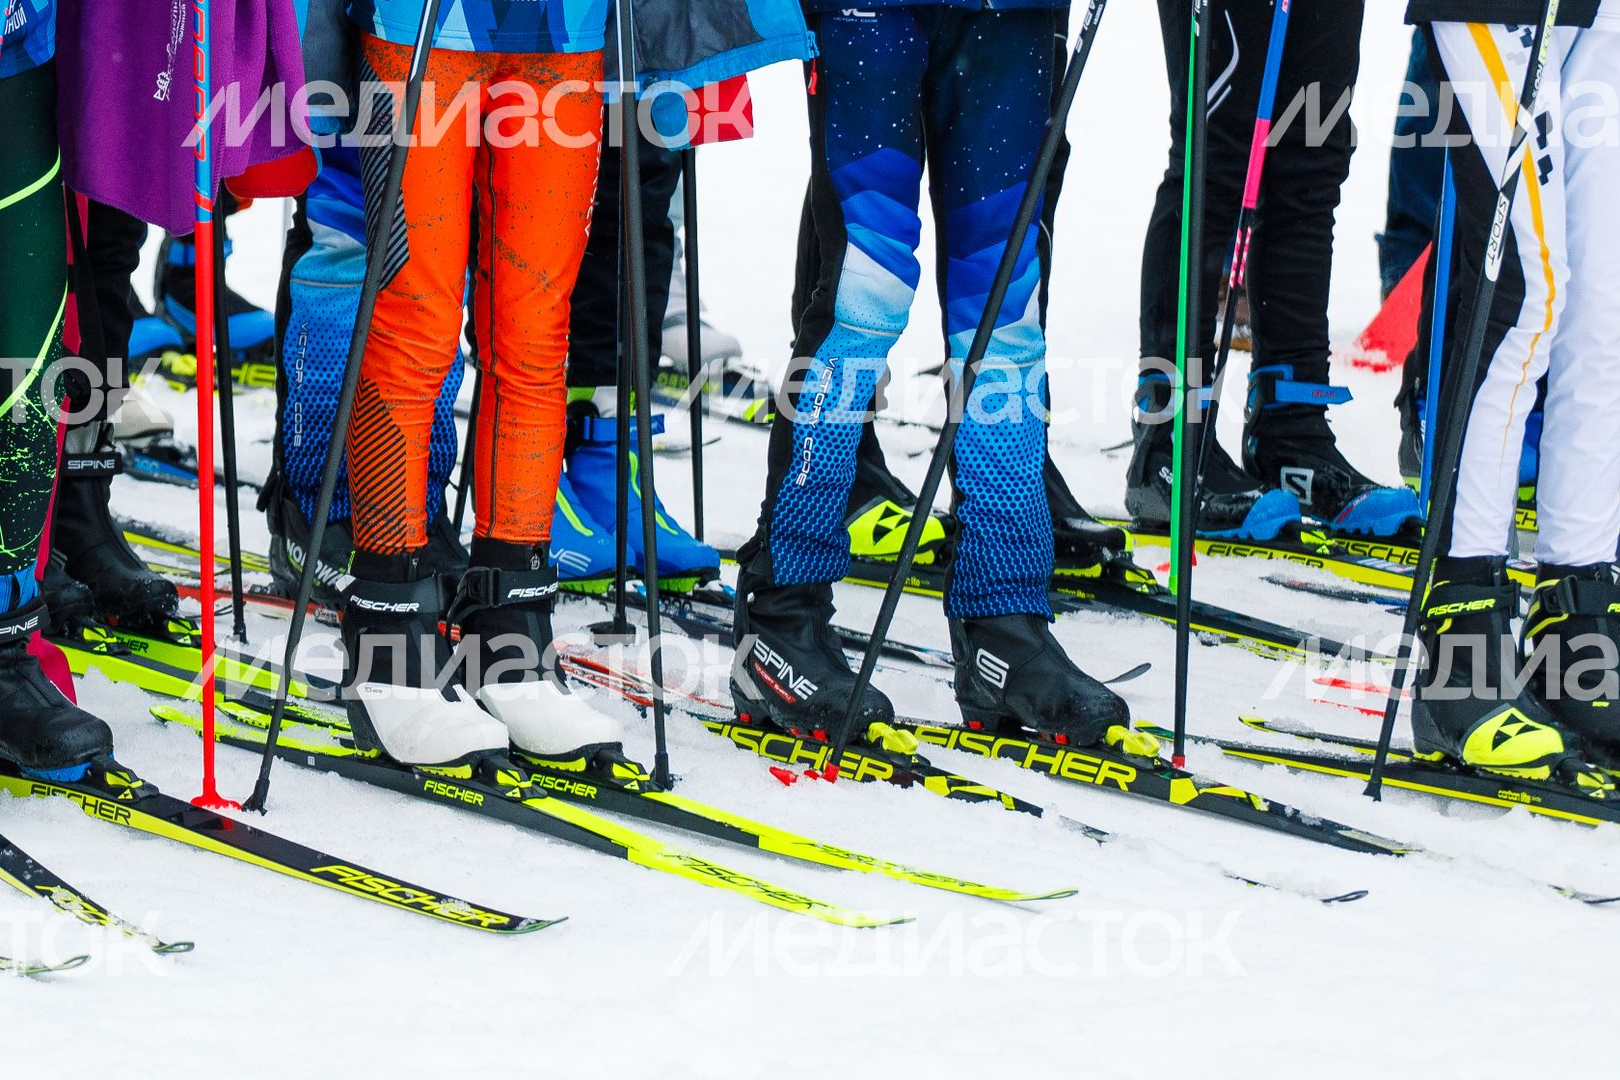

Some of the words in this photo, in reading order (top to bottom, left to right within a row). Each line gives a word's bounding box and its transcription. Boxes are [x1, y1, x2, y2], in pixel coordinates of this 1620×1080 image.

[1485, 193, 1509, 268] SPORT
[66, 458, 116, 471] SPINE
[349, 593, 420, 614] FISCHER
[1427, 597, 1496, 619] FISCHER
[752, 637, 819, 701] SPINE
[911, 726, 1137, 792] FISCHER
[423, 779, 485, 807] FISCHER
[529, 772, 598, 800] FISCHER
[310, 862, 511, 929] FISCHER
